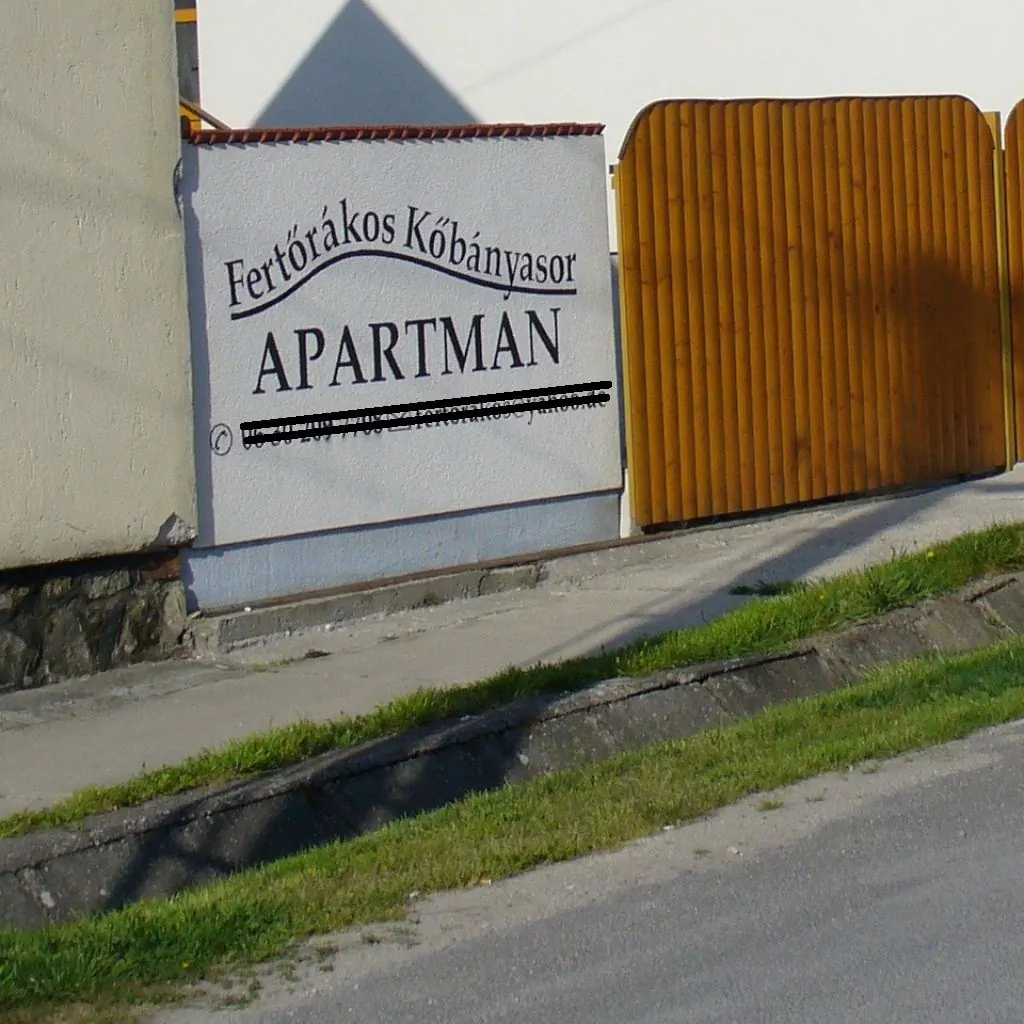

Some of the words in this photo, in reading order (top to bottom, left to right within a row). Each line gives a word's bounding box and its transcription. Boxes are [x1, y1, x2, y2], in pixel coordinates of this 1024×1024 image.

[224, 198, 396, 307] Fertőrákos
[403, 205, 577, 300] Kőbányasor
[252, 307, 562, 395] APARTMAN
